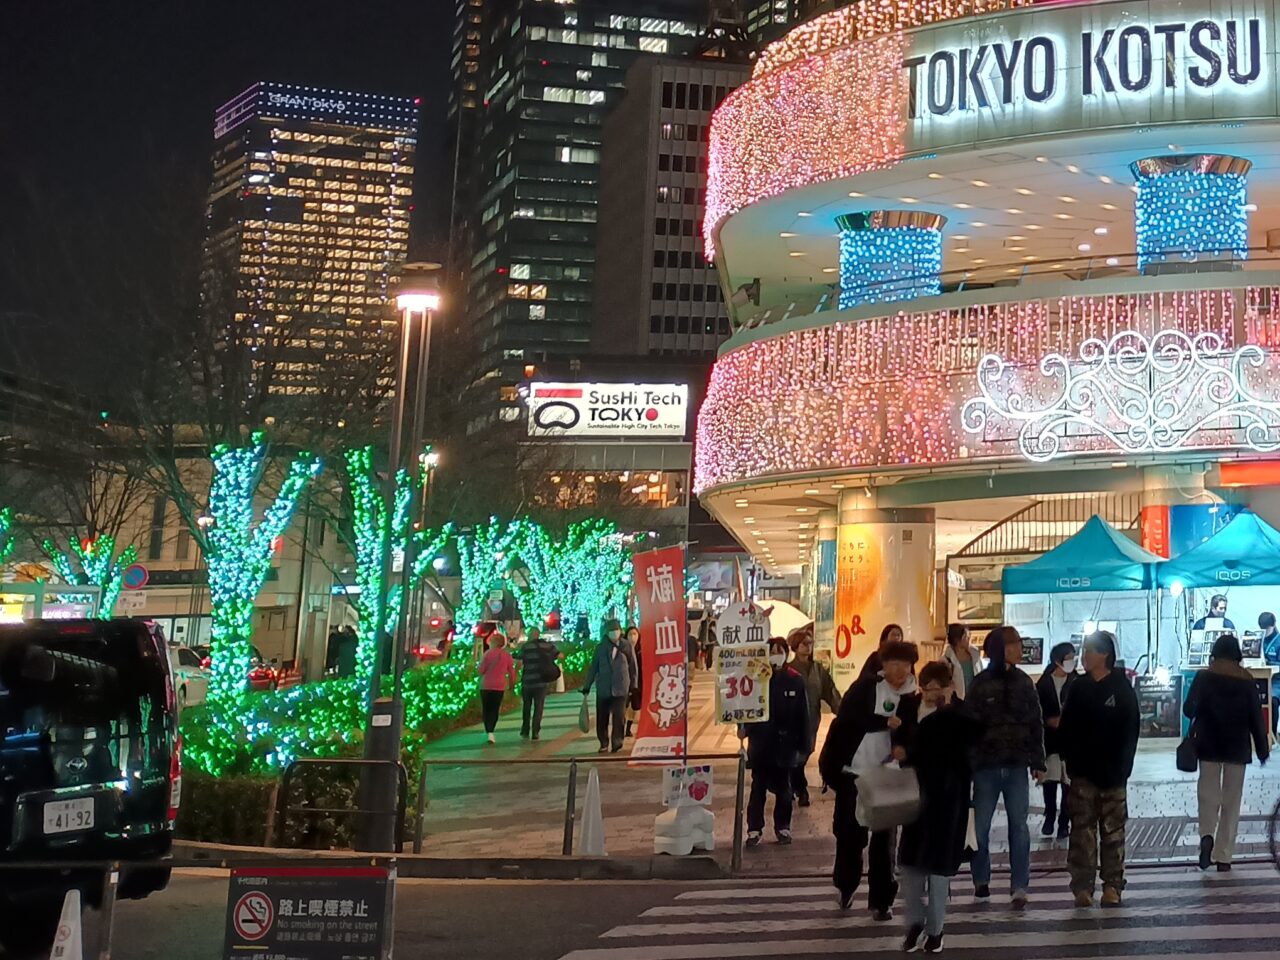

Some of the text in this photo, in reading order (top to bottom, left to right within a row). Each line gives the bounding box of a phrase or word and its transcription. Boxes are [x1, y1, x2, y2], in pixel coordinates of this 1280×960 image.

[903, 34, 1056, 119] TOKYO
[1082, 18, 1261, 94] KOTSU
[589, 391, 681, 405] SusHi Tech
[588, 407, 659, 422] TOKYO
[1056, 577, 1091, 588] IQOS
[1215, 570, 1250, 582] IQOS
[722, 623, 765, 645] 献血
[725, 674, 754, 700] 30
[55, 810, 91, 828] 41-92
[278, 899, 369, 918] 路上喫煙禁止
[277, 919, 289, 929] No
[291, 919, 325, 931] smoking
[327, 921, 338, 930] on
[339, 920, 353, 930] the
